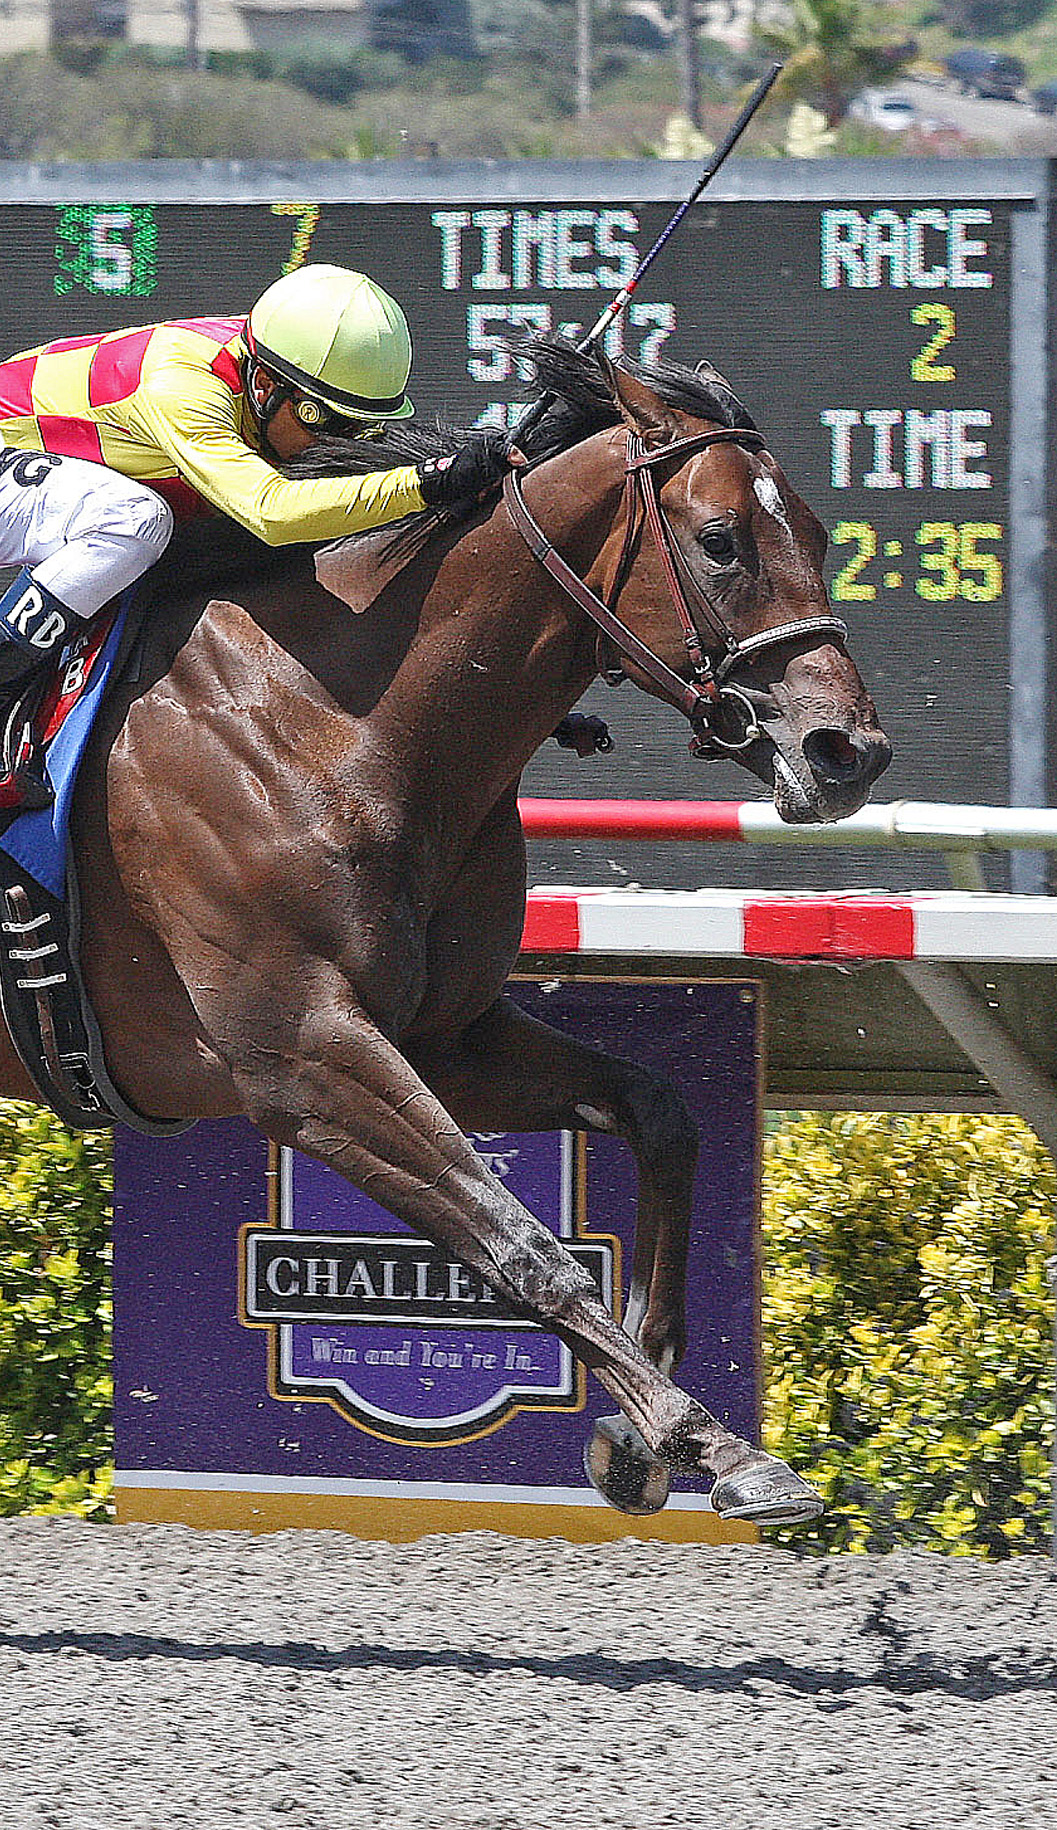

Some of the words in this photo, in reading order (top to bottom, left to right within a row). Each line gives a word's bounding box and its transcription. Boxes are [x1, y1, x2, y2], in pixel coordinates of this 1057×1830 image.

[89, 211, 133, 291] 5
[431, 210, 641, 290] TIMES
[821, 209, 994, 290] RACE
[909, 303, 957, 382] 2
[821, 409, 994, 490] TIME
[831, 522, 1005, 602] 2:35
[265, 1256, 496, 1303] CHALLE
[310, 1337, 359, 1364] Win
[364, 1340, 411, 1367] and
[419, 1340, 497, 1370] You're
